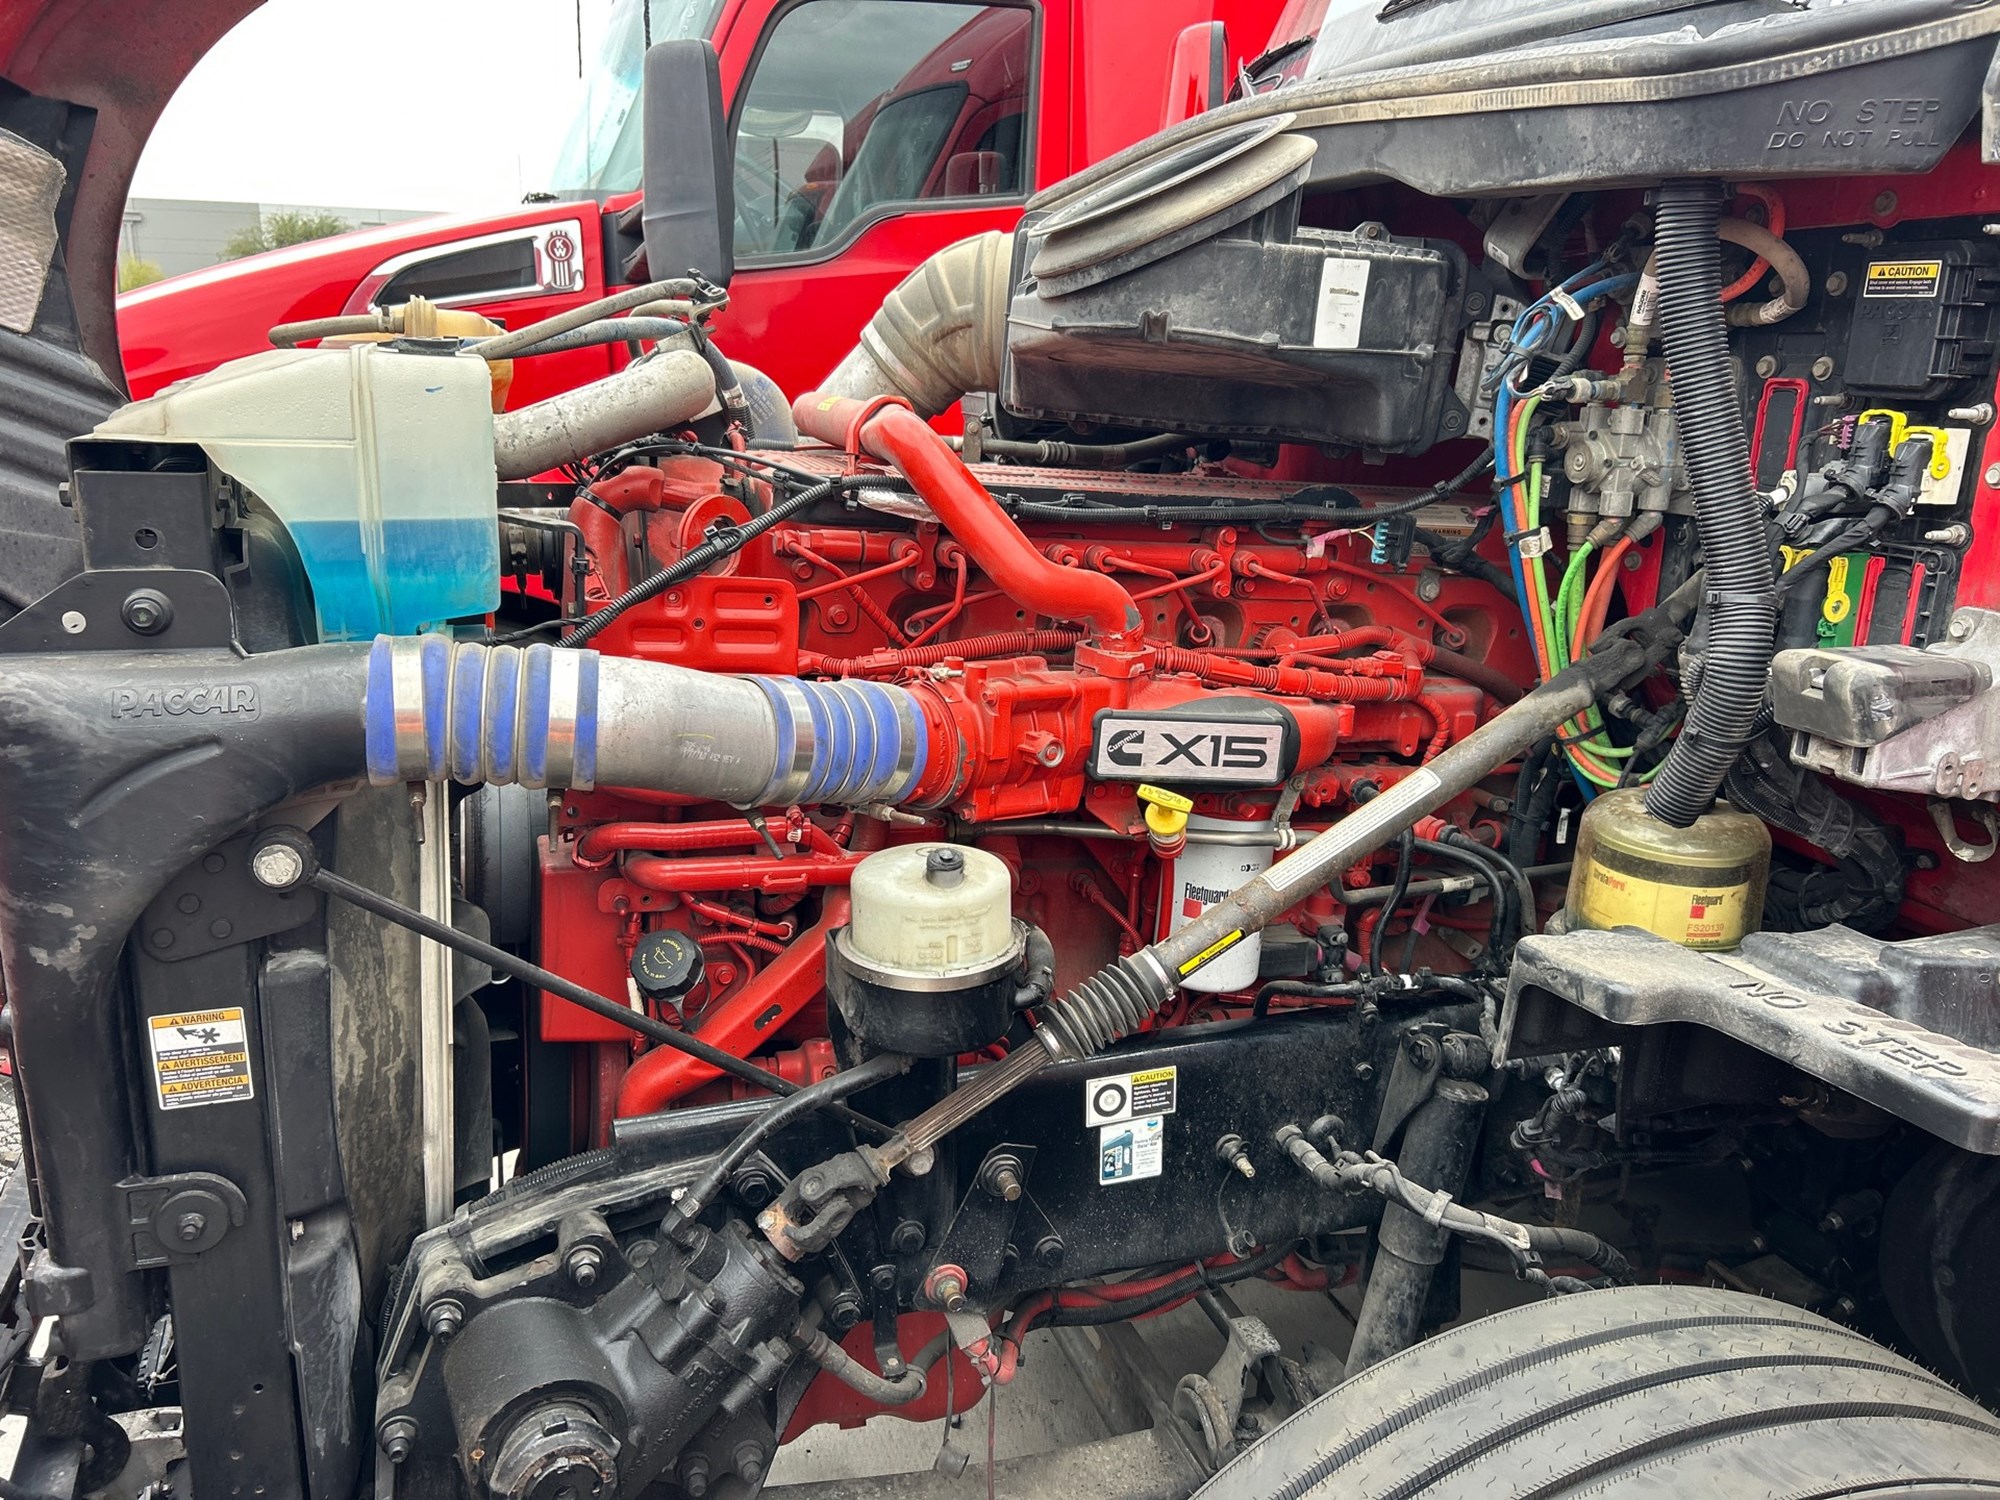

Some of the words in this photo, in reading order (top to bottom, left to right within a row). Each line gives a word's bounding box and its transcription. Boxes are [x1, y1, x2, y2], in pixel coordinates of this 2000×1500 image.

[1776, 99, 1833, 126] NO
[1856, 98, 1941, 124] STEP
[1766, 131, 1807, 150] DO
[1822, 130, 1873, 148] NOT
[1885, 129, 1941, 147] PULL
[1888, 267, 1930, 277] CAUTION
[111, 685, 256, 718] PACCAR
[1107, 729, 1143, 753] Cummins
[1155, 732, 1268, 769] X15
[1184, 882, 1230, 906] Fleetguard
[1691, 894, 1725, 908] Fleetguard
[1686, 923, 1725, 933] FS20139
[181, 1012, 225, 1024] WARNING
[1729, 981, 1808, 1009] NO
[1822, 1020, 1968, 1077] STEP
[173, 1053, 244, 1069] AVERTISSEMENT
[181, 1076, 243, 1091] ADVERTENCIA
[1139, 1070, 1174, 1082] CAUTION
